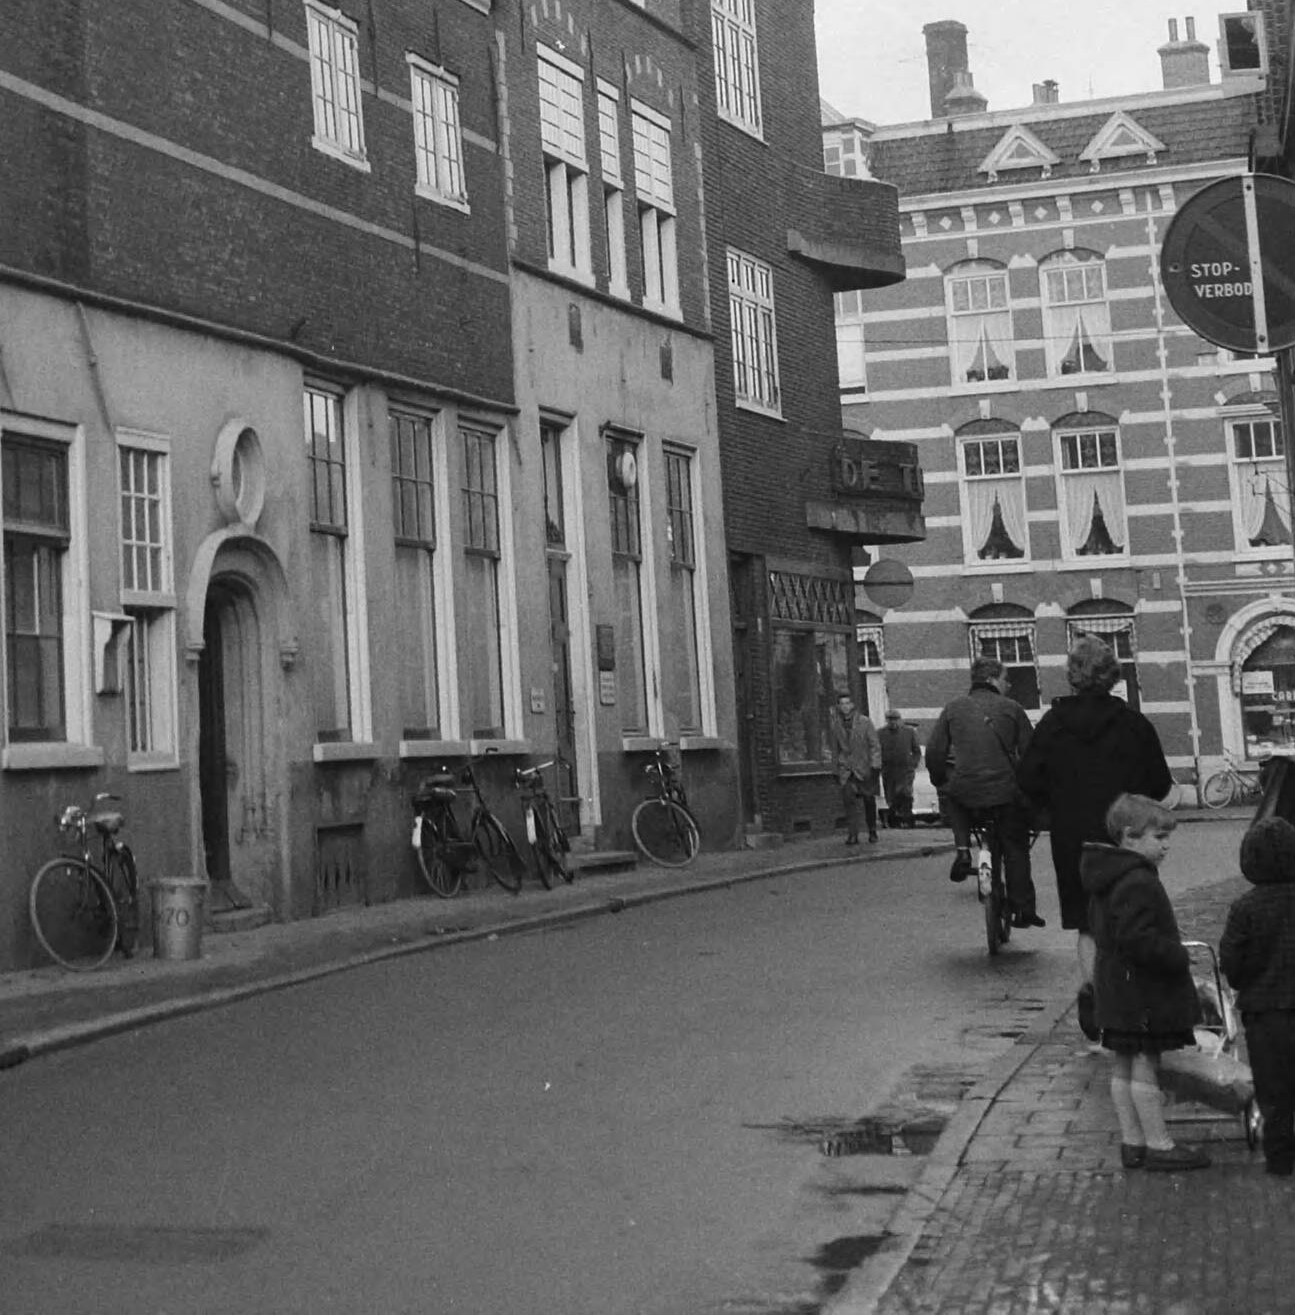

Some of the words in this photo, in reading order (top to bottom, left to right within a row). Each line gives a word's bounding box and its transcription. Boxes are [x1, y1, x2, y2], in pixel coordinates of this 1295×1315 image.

[1191, 262, 1240, 278] STOP-
[1194, 282, 1253, 298] VERBOD
[841, 457, 884, 491] DE
